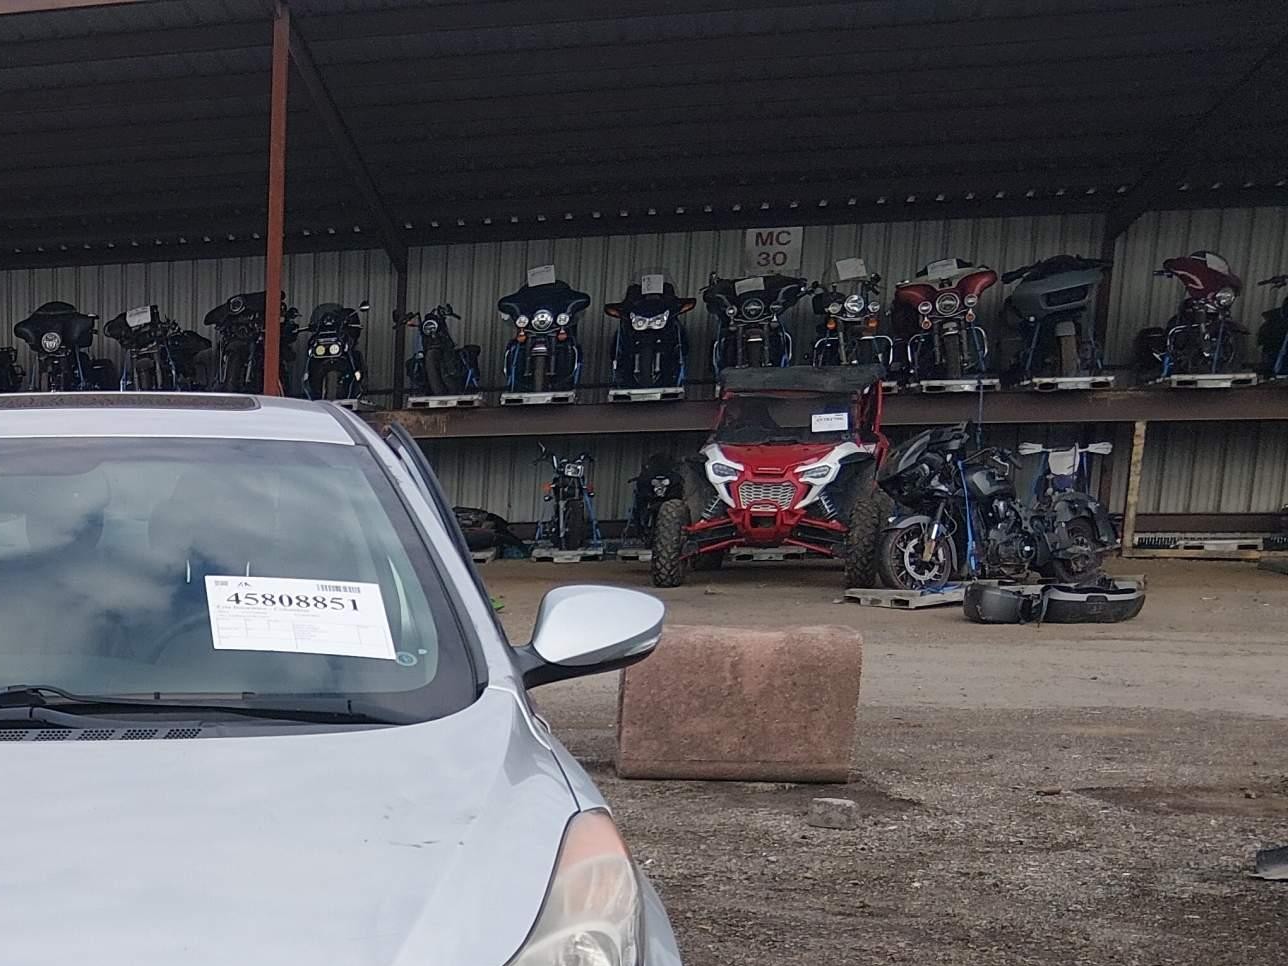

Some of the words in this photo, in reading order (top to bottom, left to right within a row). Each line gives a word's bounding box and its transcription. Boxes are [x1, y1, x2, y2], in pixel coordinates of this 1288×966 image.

[755, 230, 792, 247] MC
[757, 251, 787, 267] 30
[226, 592, 360, 613] 45808851
